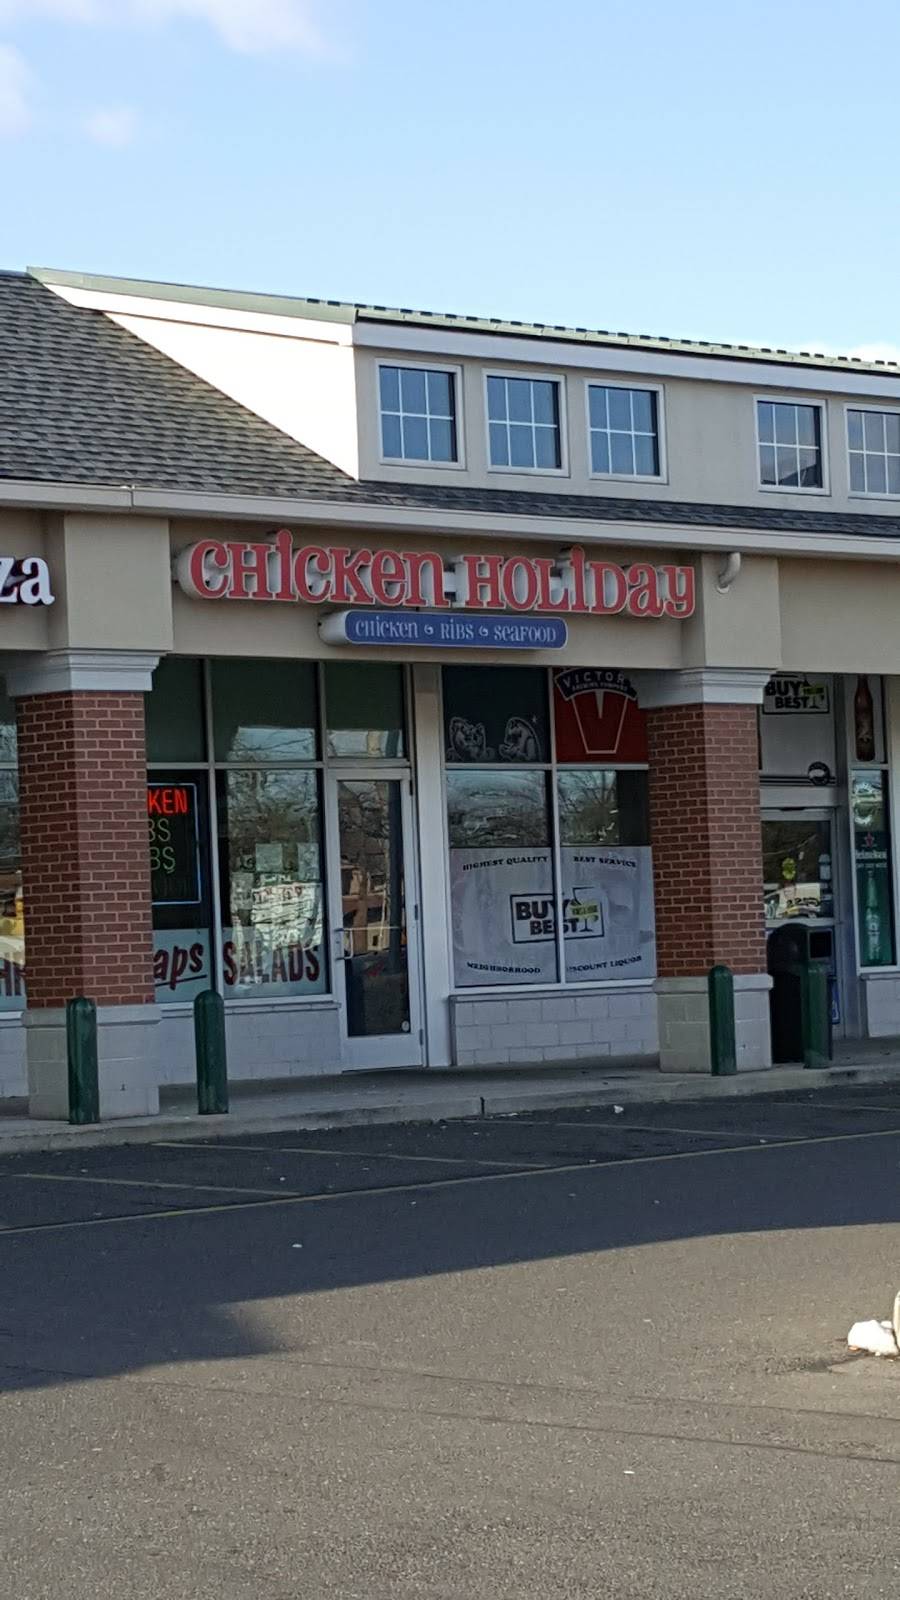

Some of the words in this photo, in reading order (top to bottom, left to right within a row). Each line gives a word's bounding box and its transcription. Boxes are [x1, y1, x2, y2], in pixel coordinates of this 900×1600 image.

[764, 680, 803, 697] BUY
[775, 695, 809, 709] BEST
[462, 858, 504, 872] HIGHEST
[506, 855, 549, 867] QUALITY
[515, 899, 570, 921] BUY
[529, 918, 580, 936] BEST
[222, 941, 320, 986] SALADS
